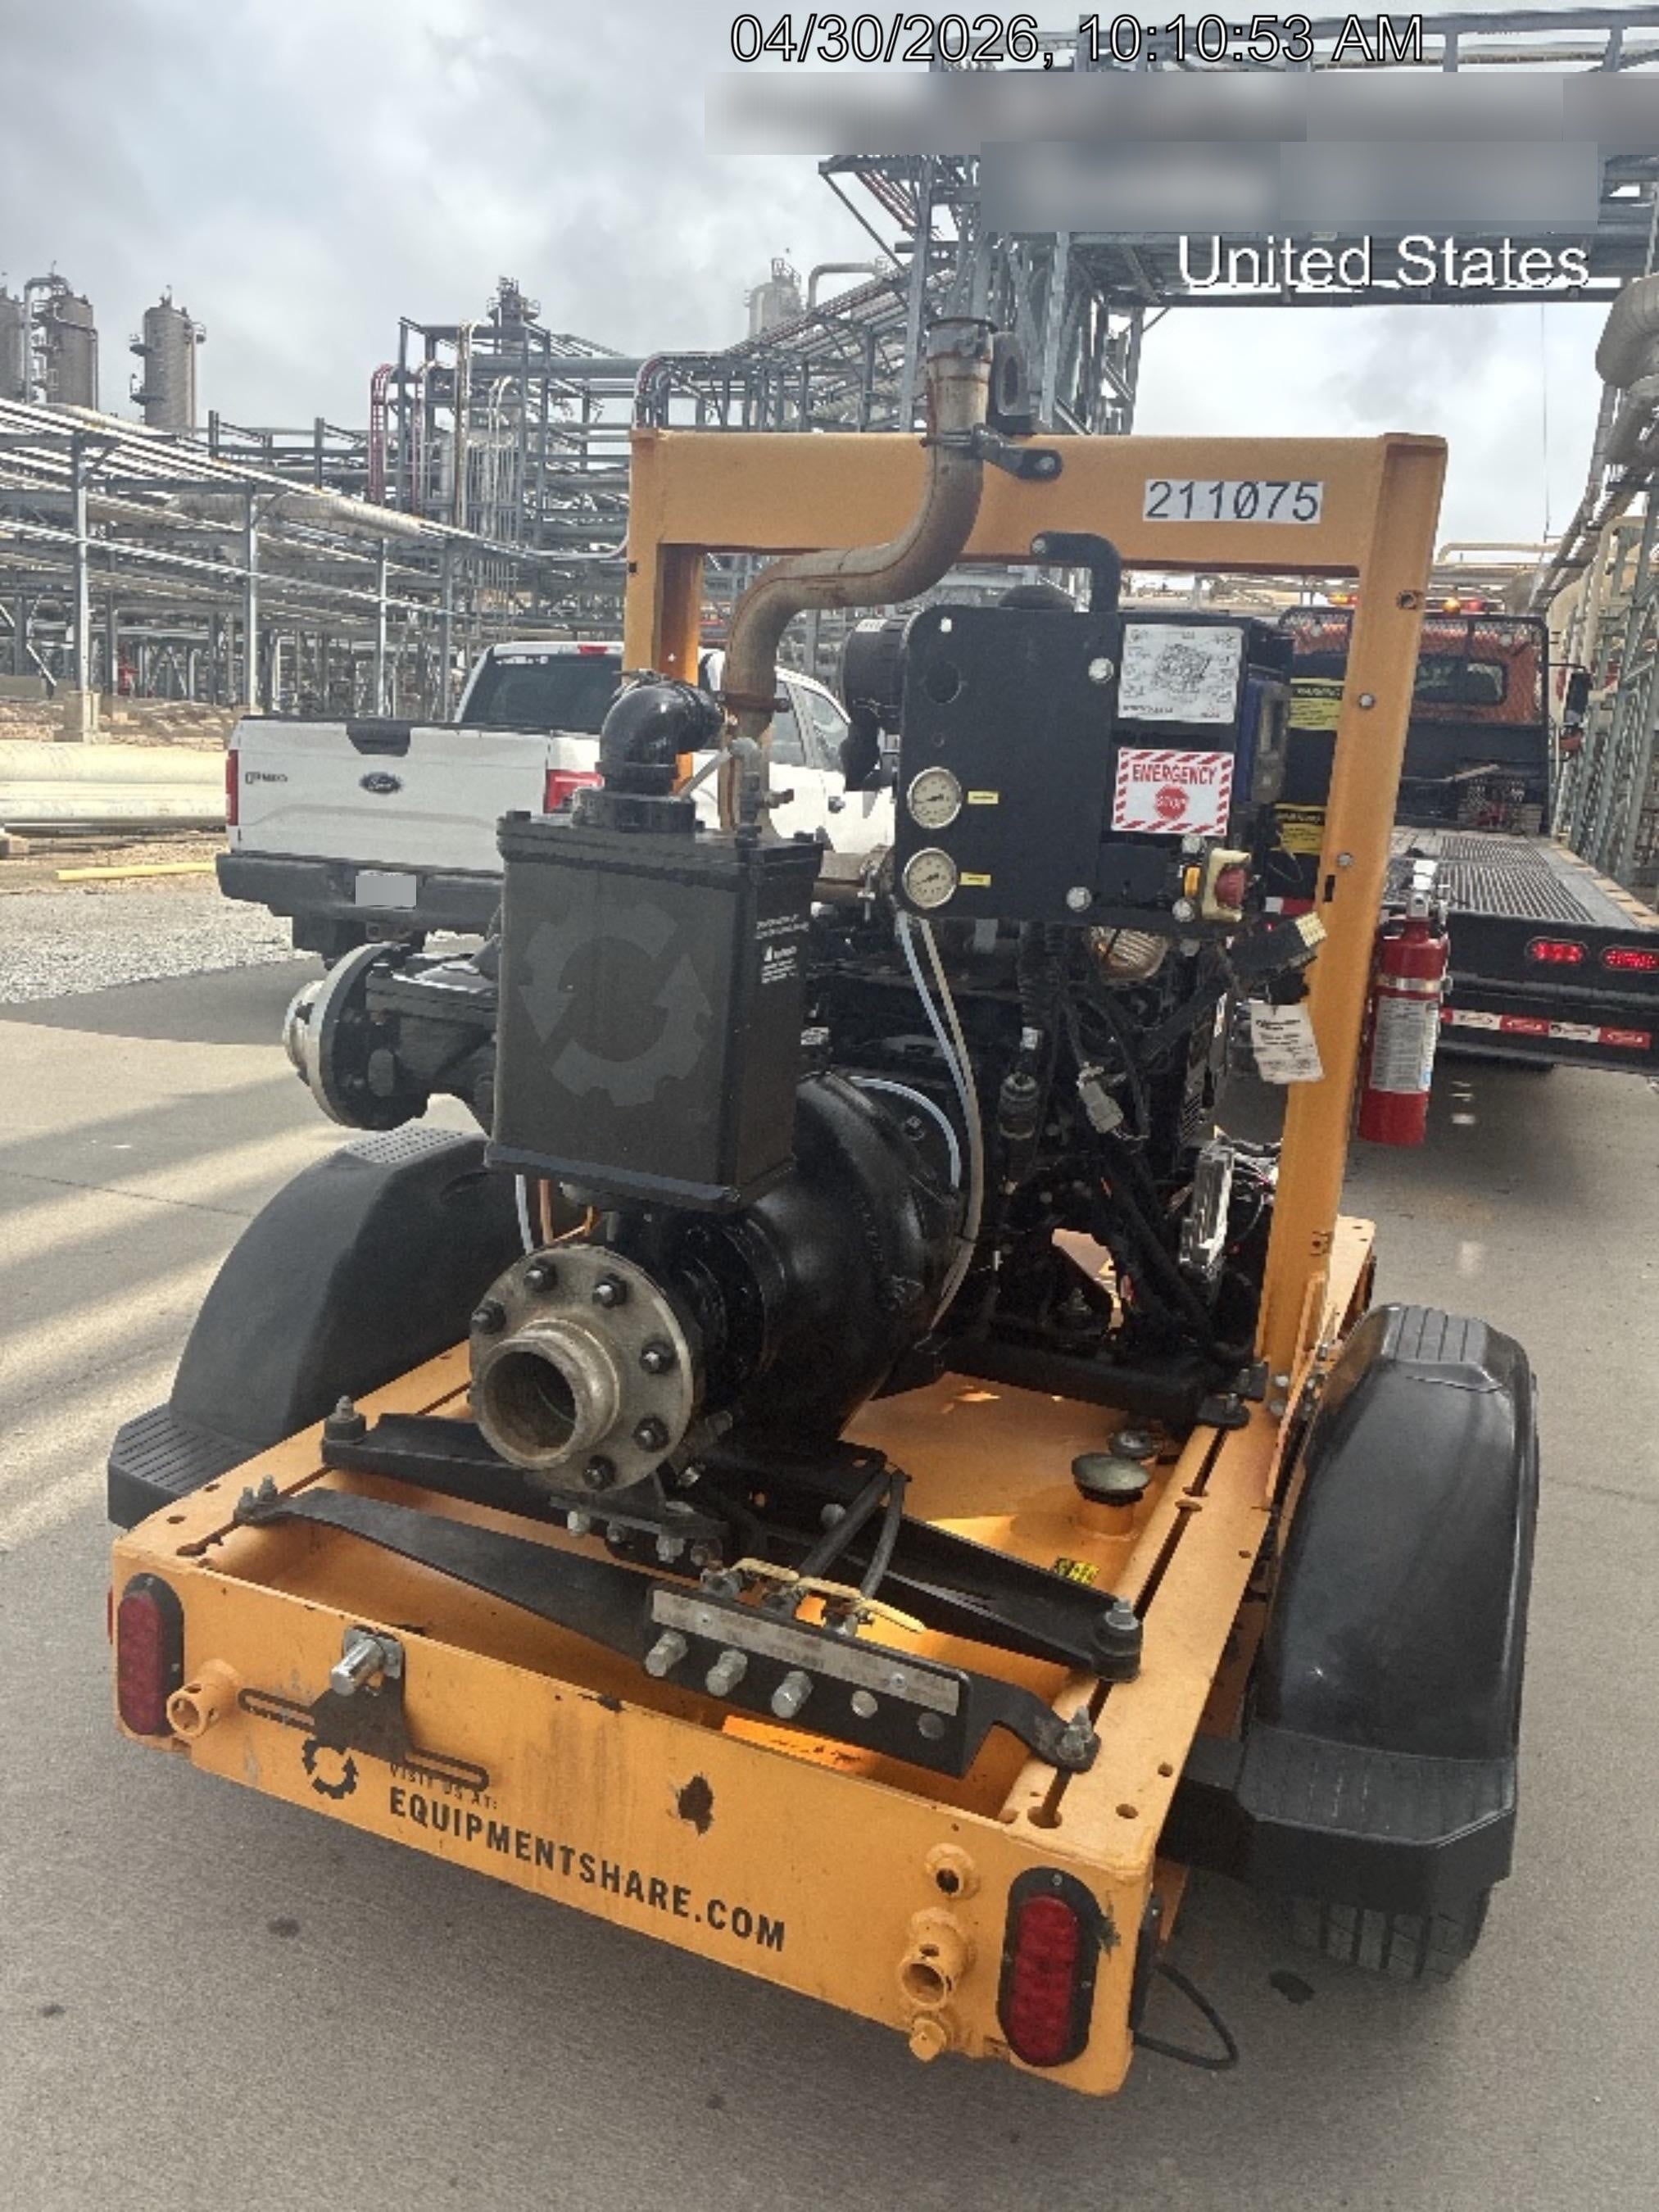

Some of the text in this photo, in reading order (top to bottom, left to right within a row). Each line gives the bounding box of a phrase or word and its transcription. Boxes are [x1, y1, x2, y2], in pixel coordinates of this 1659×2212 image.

[1146, 481, 1318, 521] 211075
[1132, 764, 1217, 785] EMERGENCY
[390, 1786, 785, 1951] EQUIPMENTSHARE.COM
